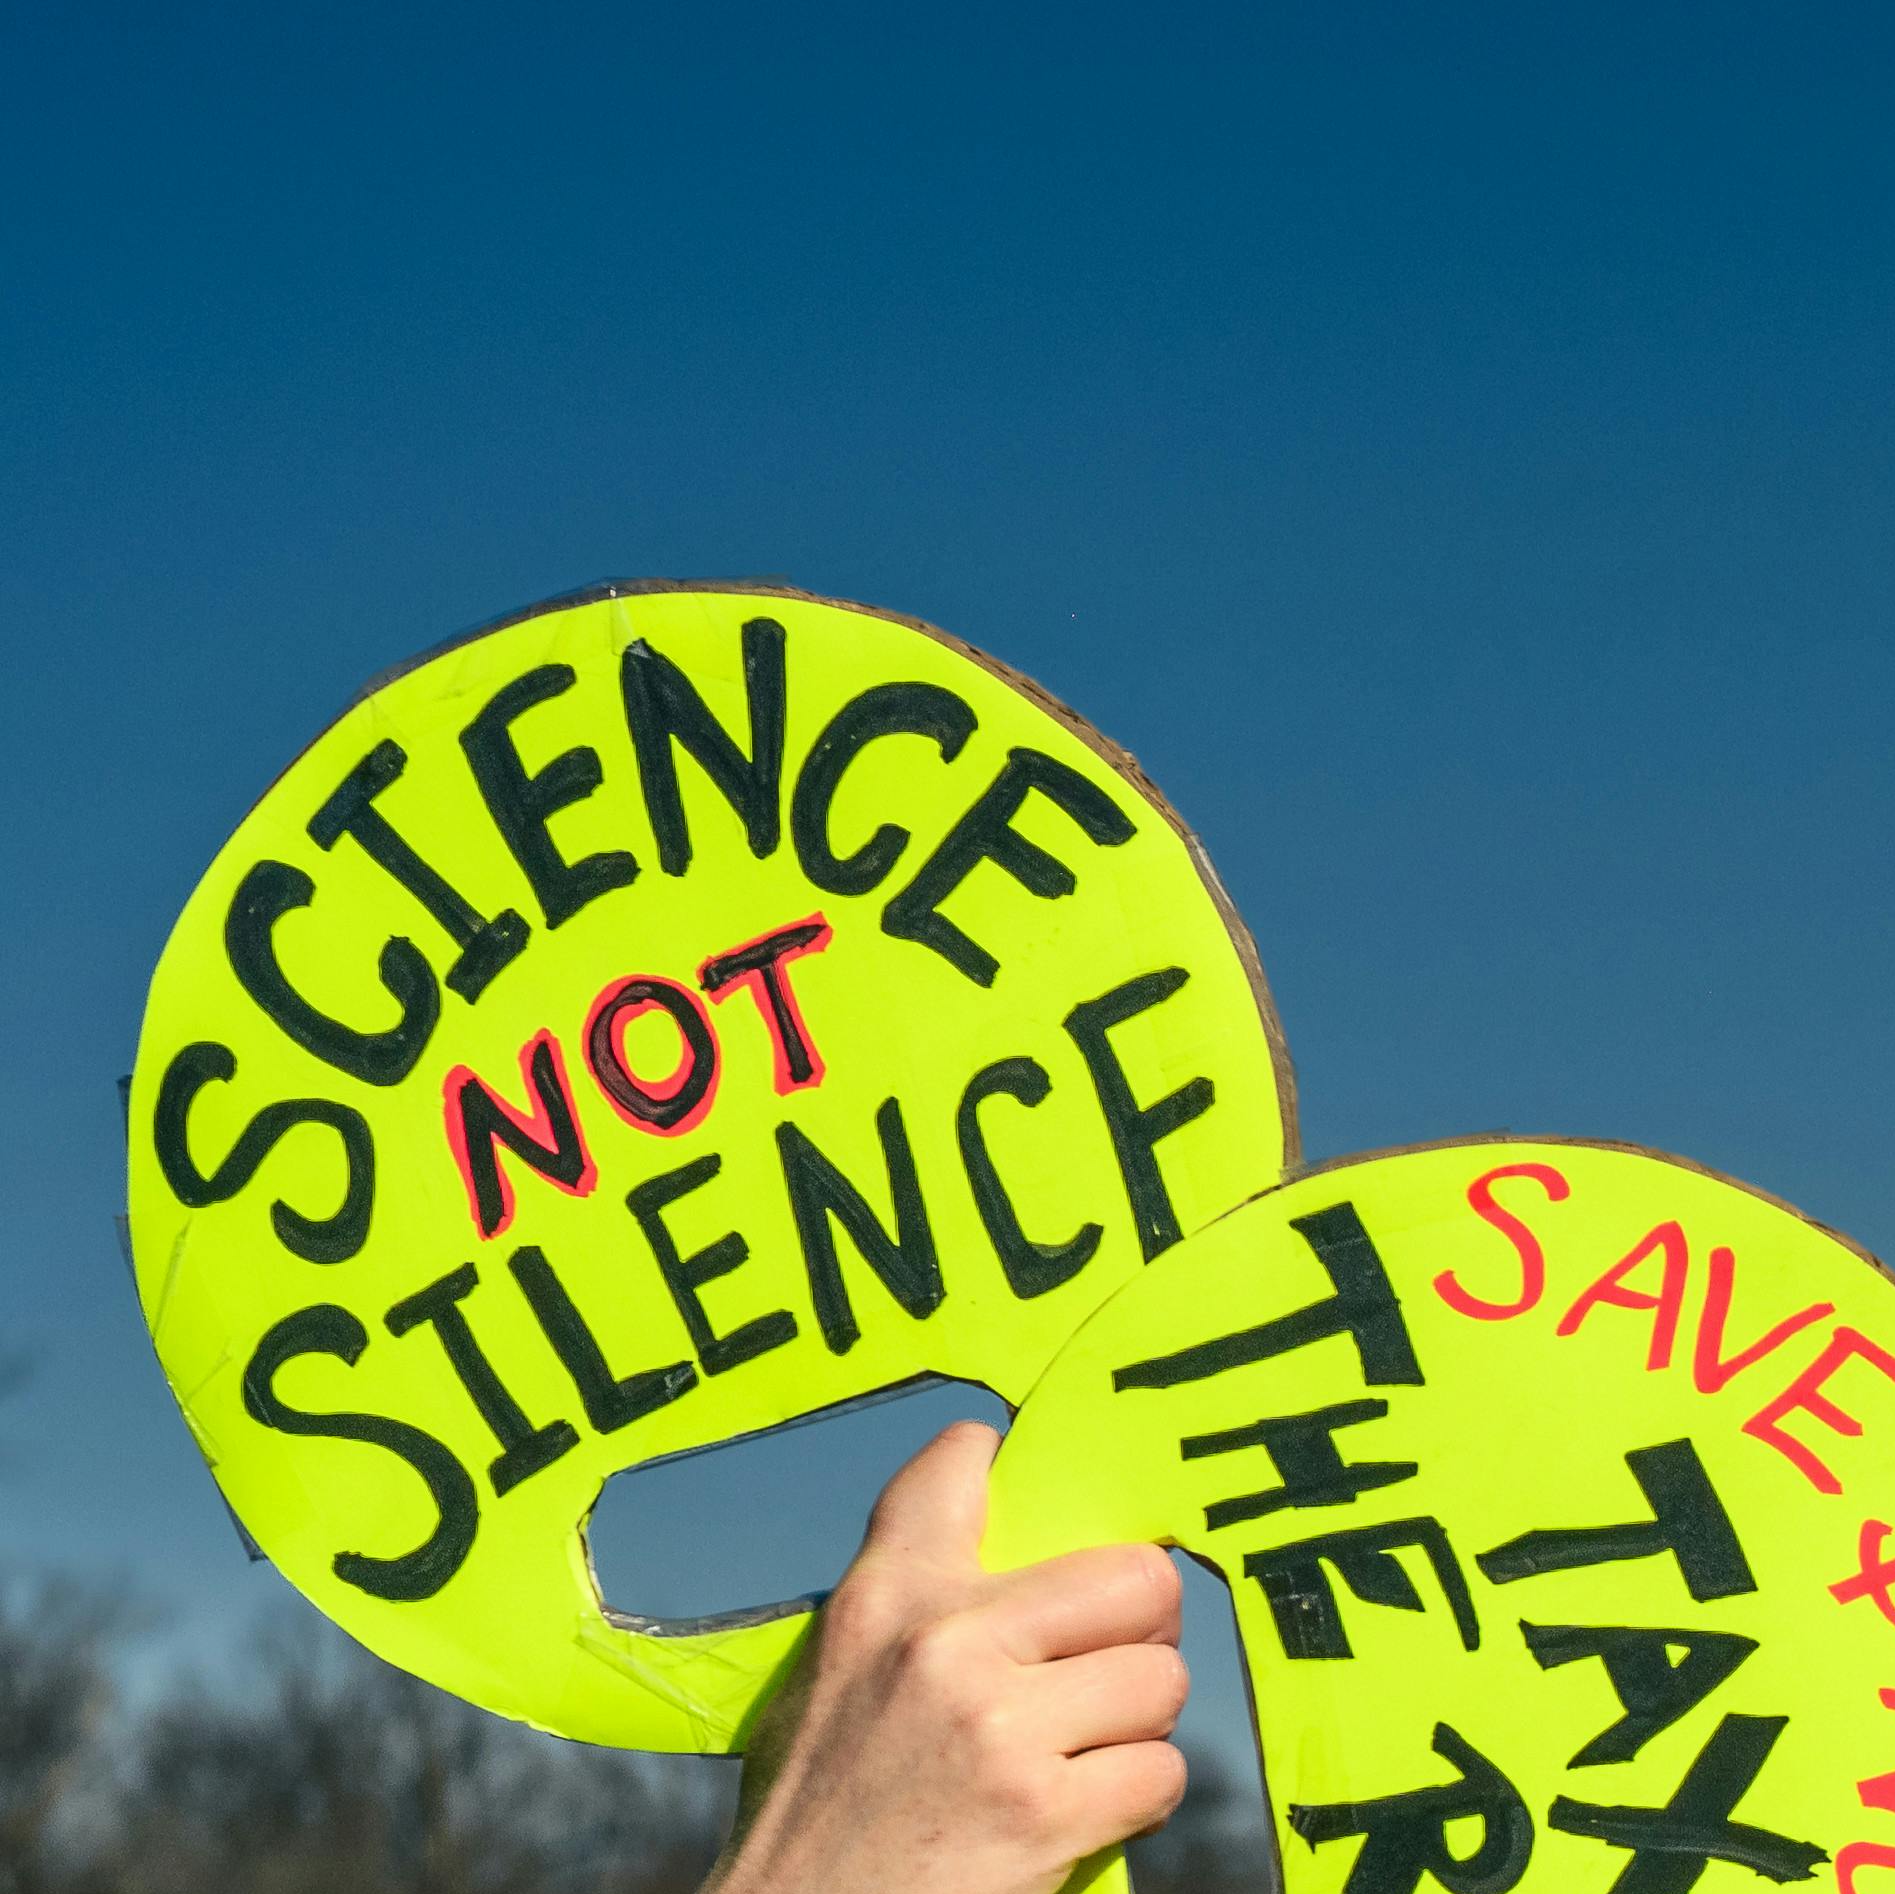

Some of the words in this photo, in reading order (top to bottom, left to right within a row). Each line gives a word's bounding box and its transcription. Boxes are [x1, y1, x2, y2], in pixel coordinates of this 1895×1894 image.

[153, 617, 1137, 1265] SCIENCE
[443, 911, 833, 1241] NOT
[242, 966, 1216, 1602] SILENCE
[1112, 1200, 1482, 1661] THE
